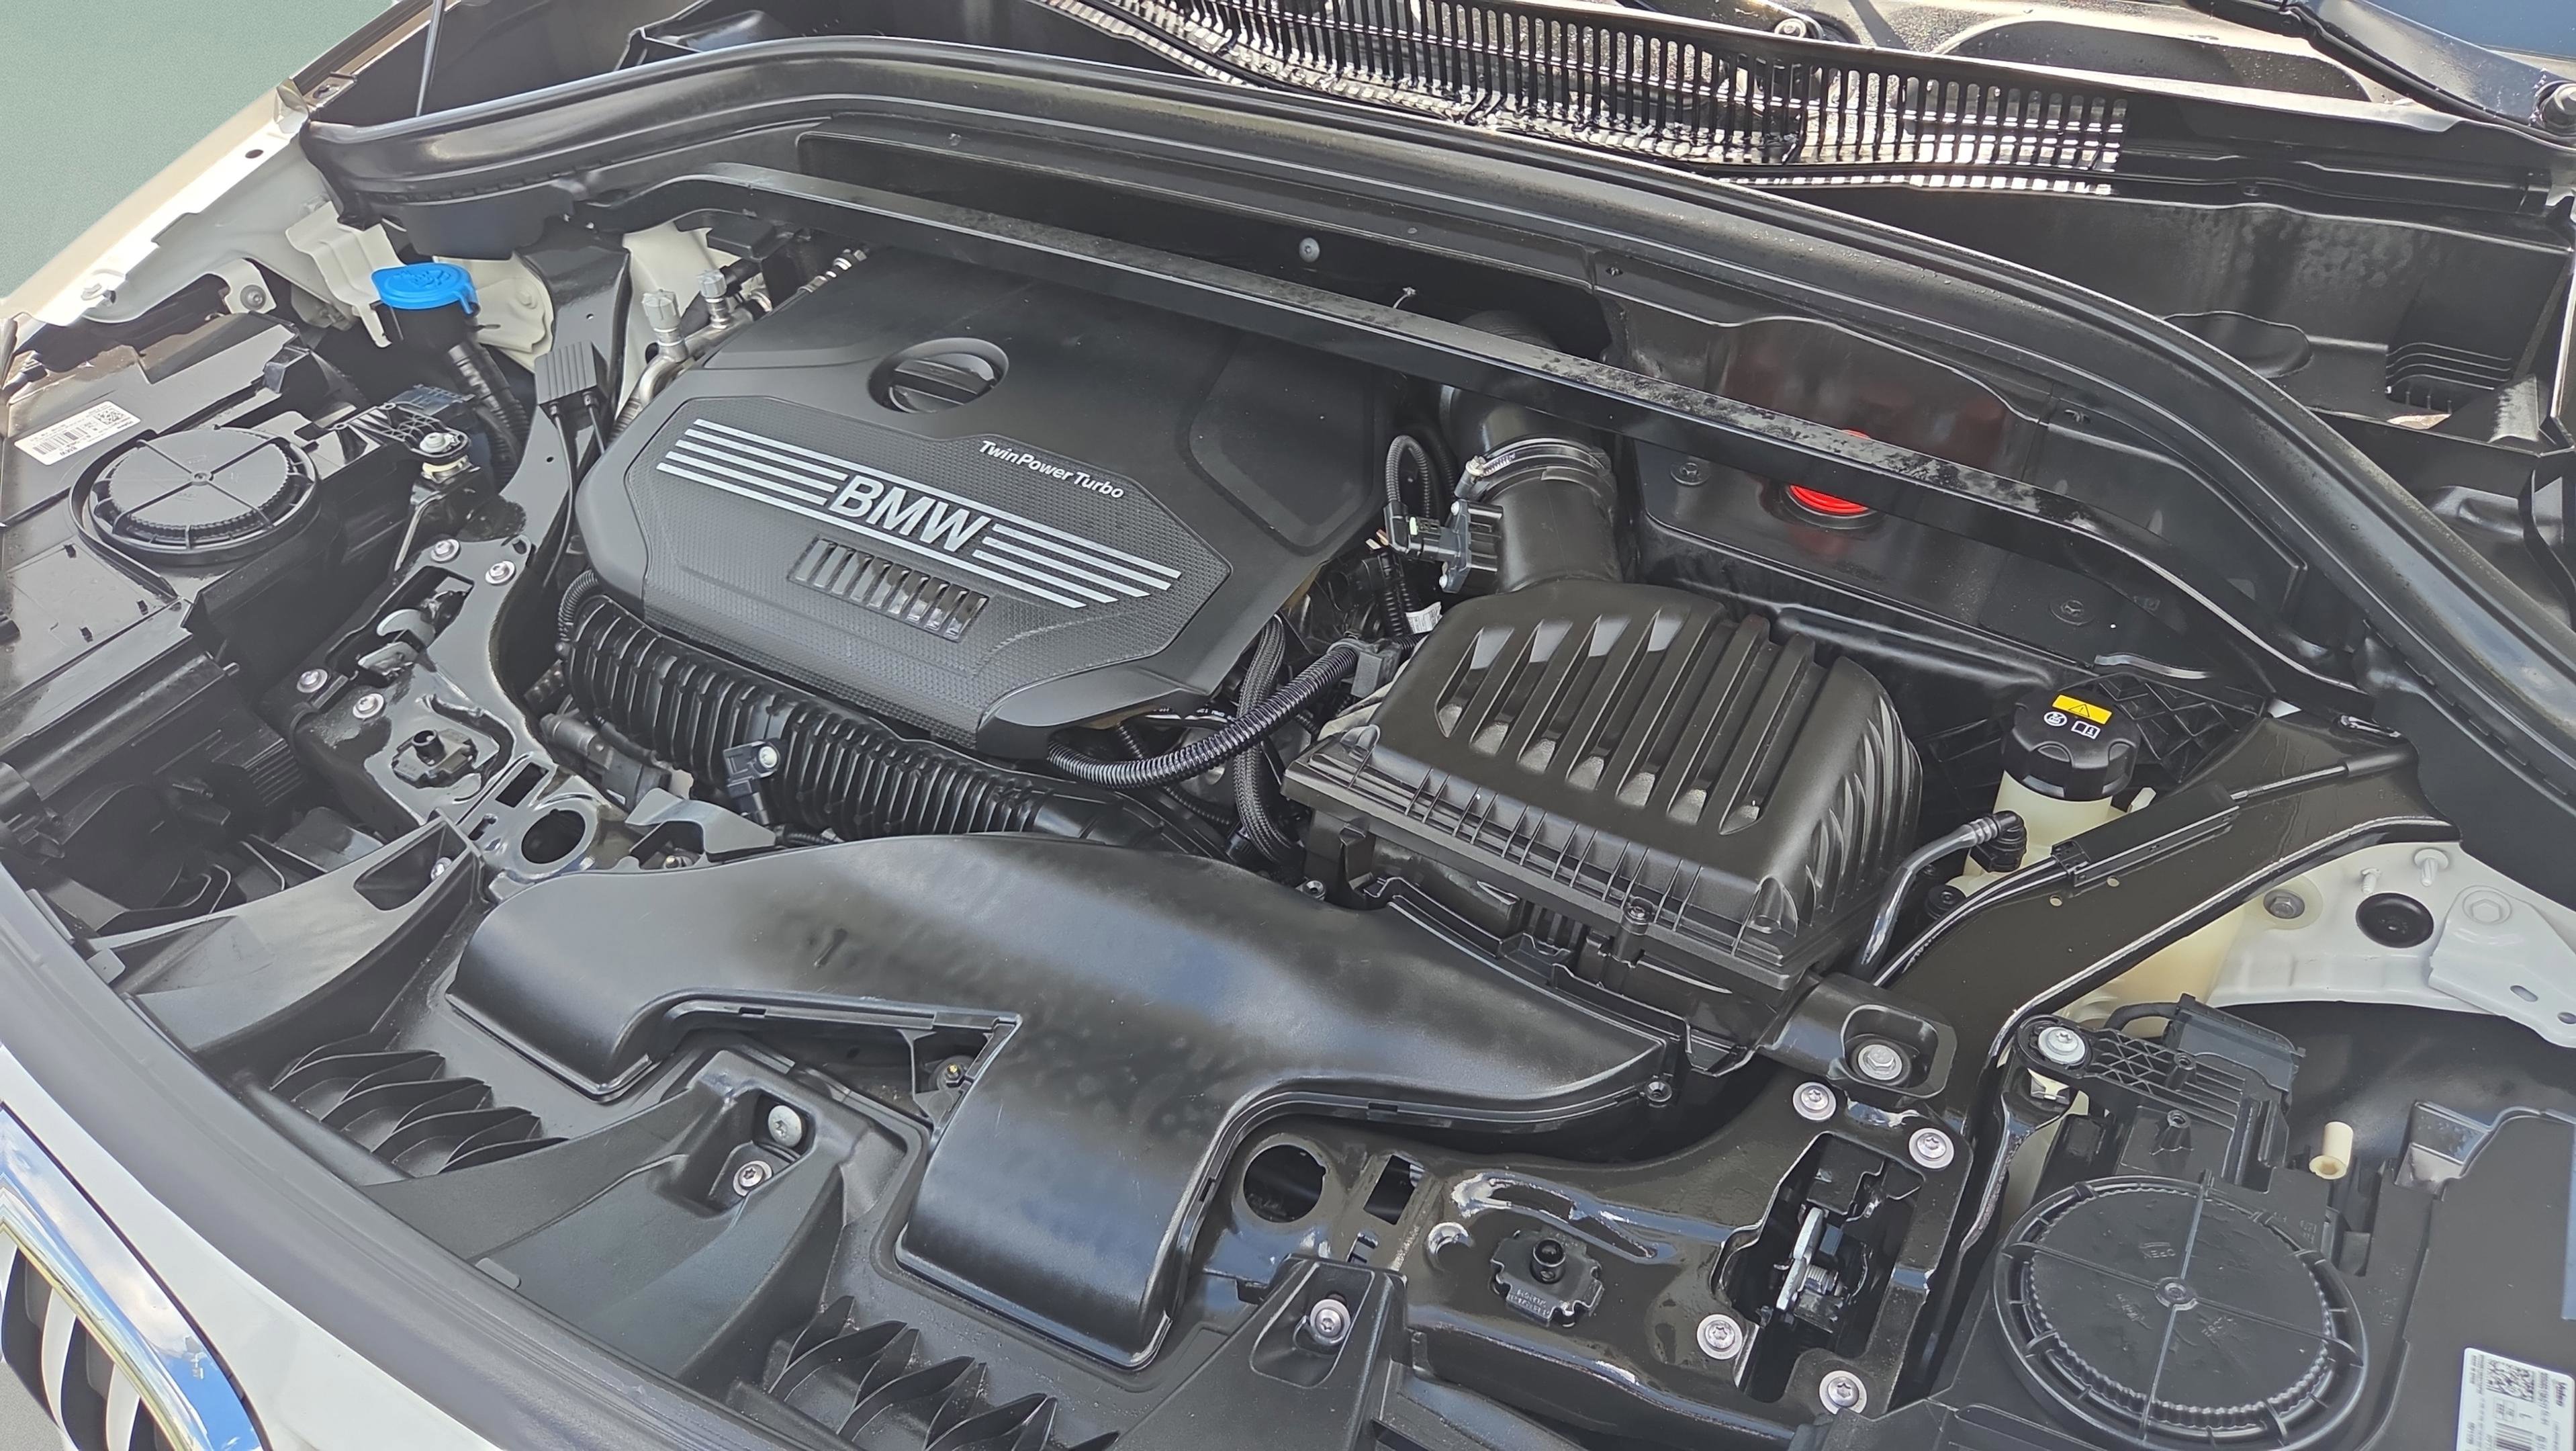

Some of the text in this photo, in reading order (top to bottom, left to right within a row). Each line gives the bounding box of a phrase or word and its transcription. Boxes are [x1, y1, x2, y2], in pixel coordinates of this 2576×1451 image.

[979, 440, 1124, 498] TwinPower Turbo
[829, 474, 992, 552] BMW
